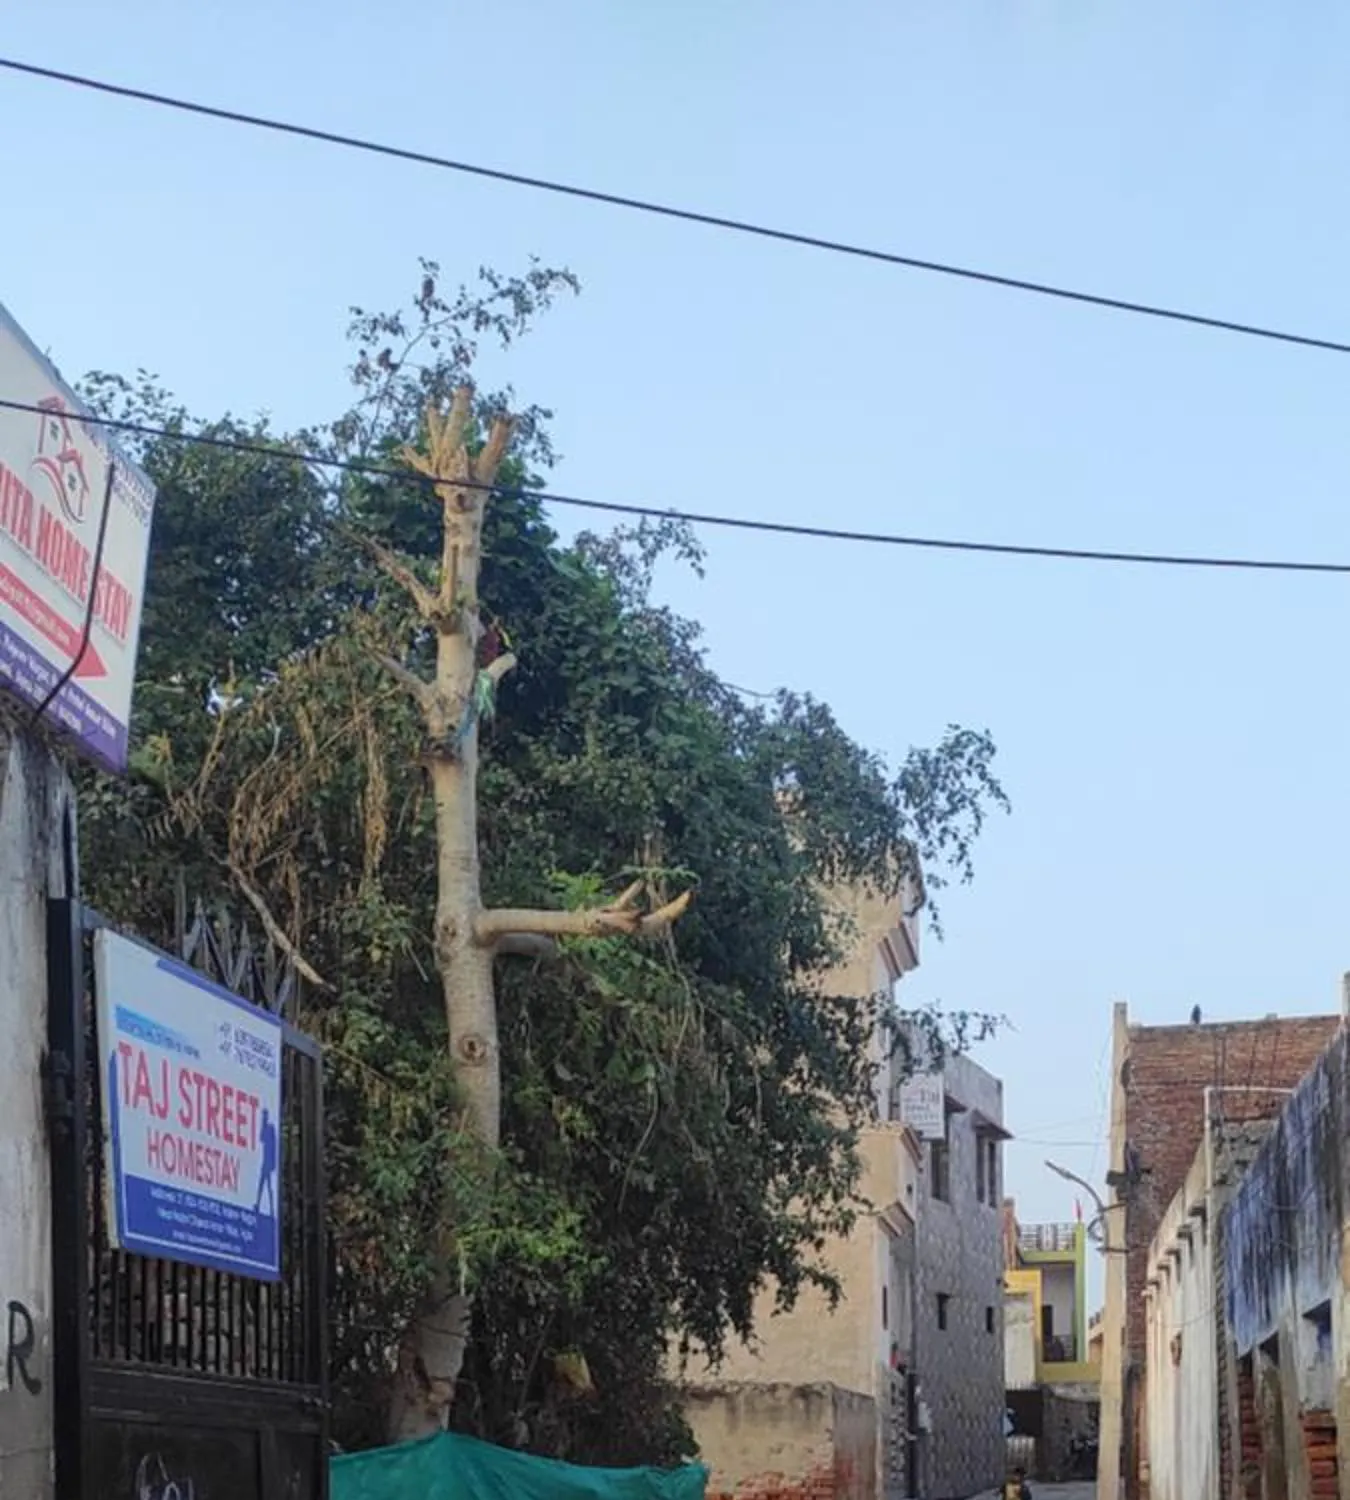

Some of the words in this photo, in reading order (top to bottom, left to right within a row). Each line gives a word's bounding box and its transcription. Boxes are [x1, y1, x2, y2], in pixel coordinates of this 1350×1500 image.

[36, 504, 90, 604] HOME
[92, 564, 133, 641] STAY
[118, 1039, 170, 1121] TAJ
[178, 1068, 260, 1151] STREET
[146, 1128, 240, 1192] HOMESTAY
[6, 1301, 42, 1395] R
